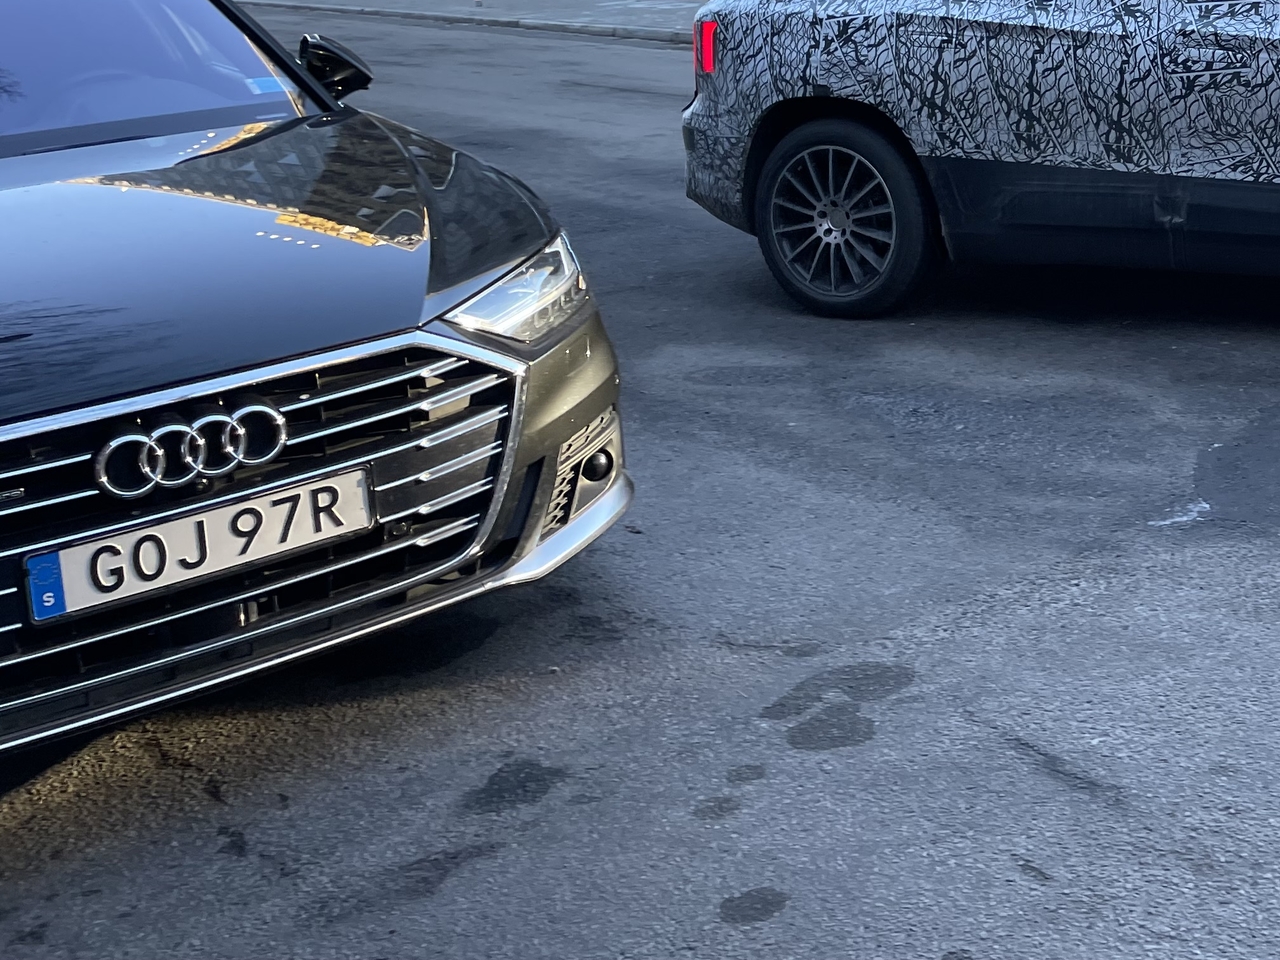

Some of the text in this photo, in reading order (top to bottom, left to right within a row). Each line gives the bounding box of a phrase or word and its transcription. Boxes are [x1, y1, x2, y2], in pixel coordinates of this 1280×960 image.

[89, 485, 345, 593] GOJ 97R
[42, 592, 55, 606] S
